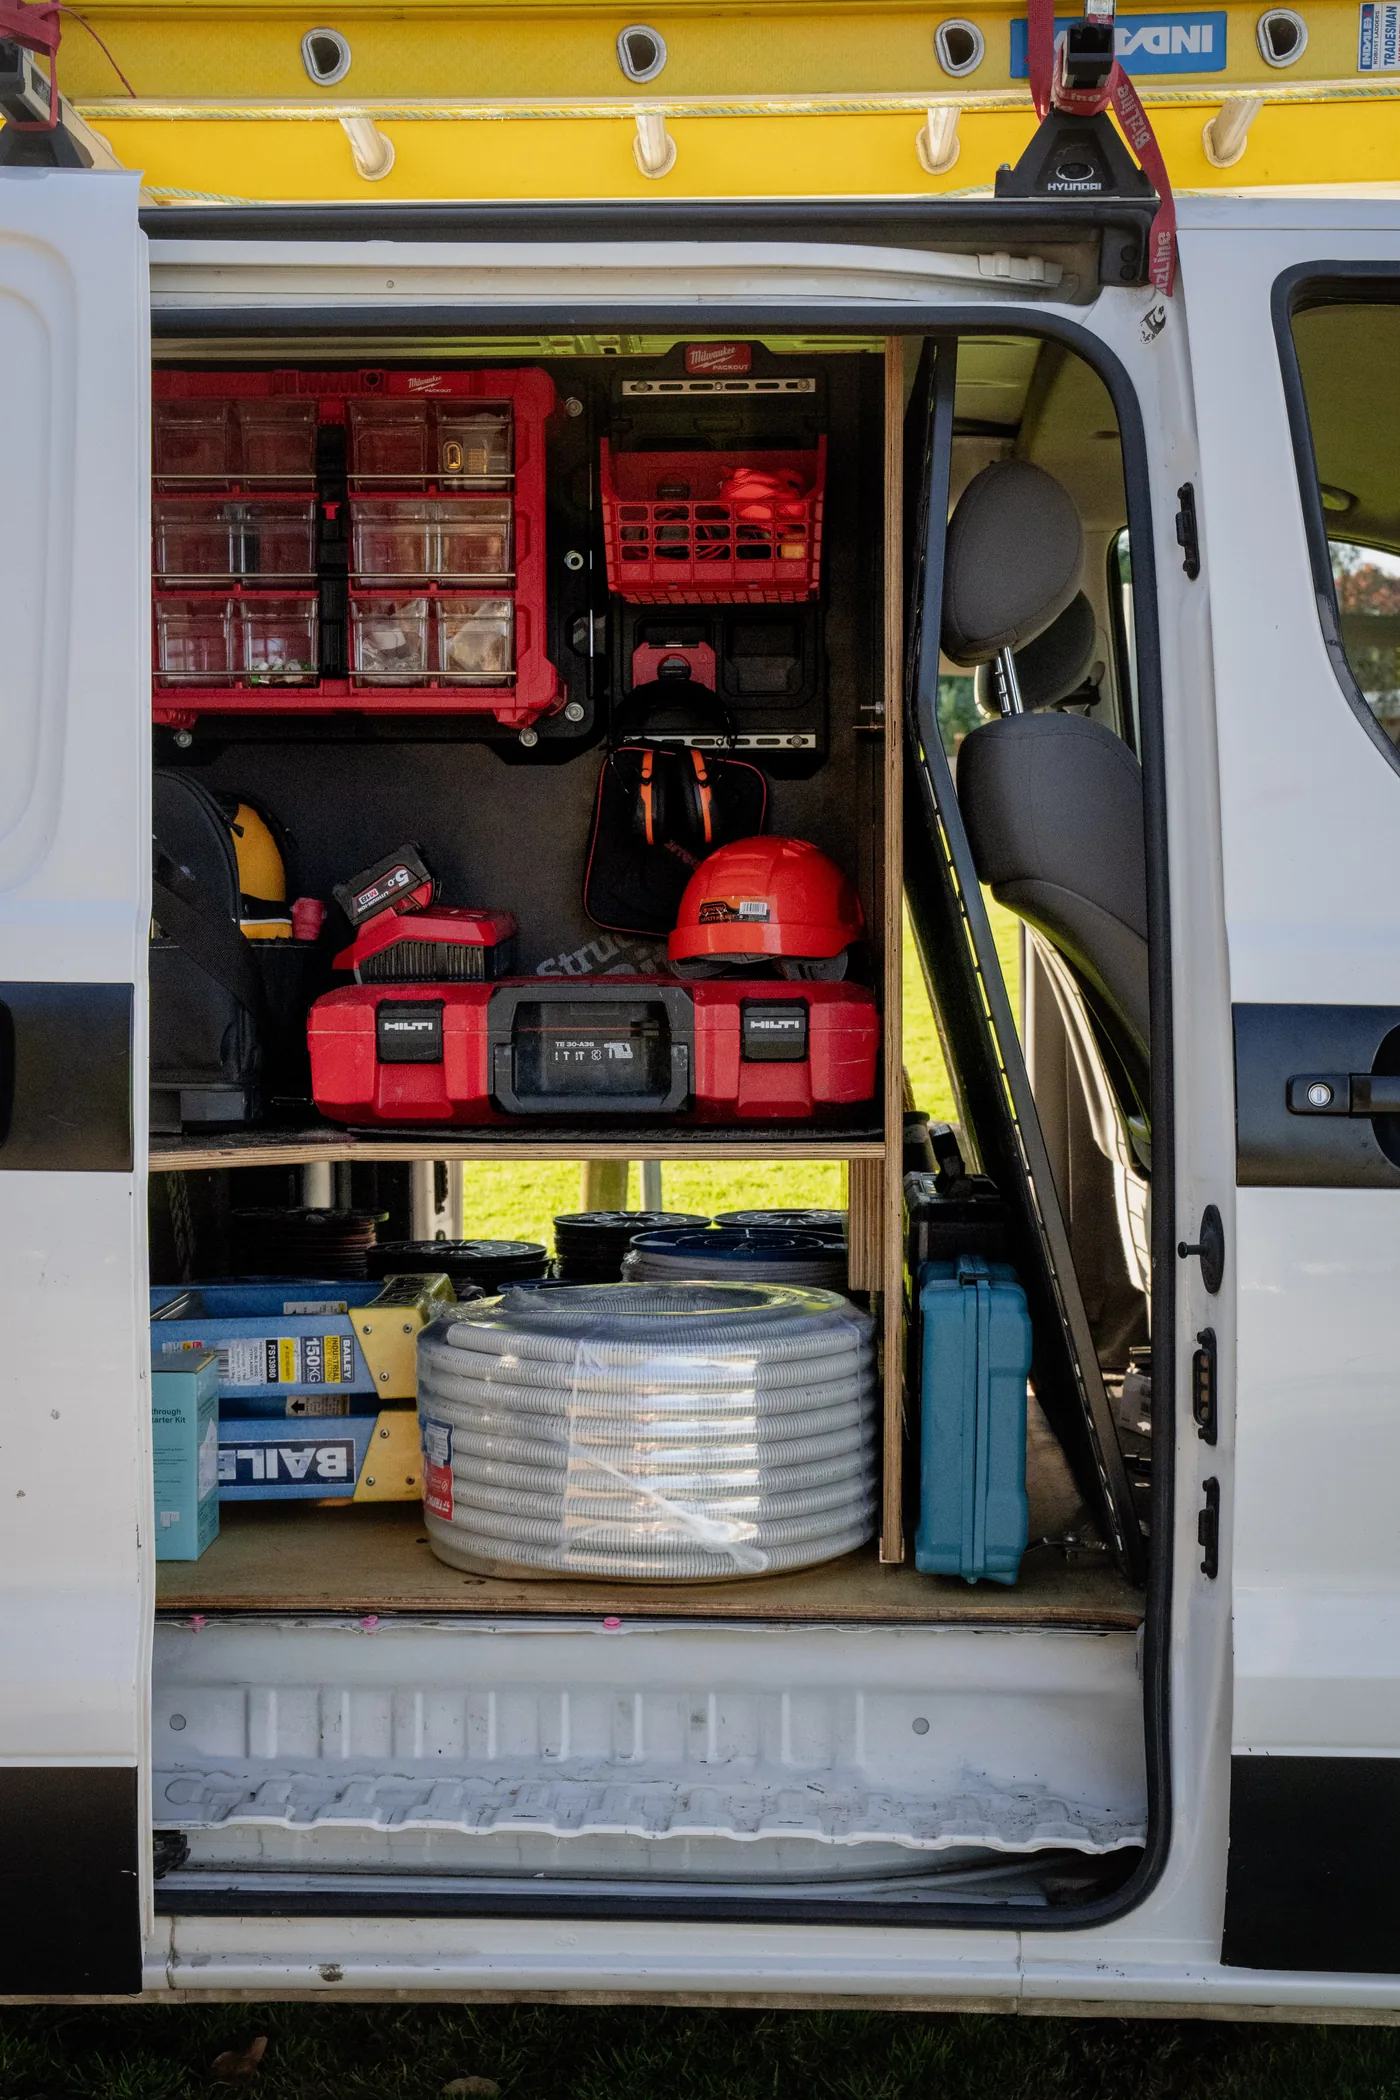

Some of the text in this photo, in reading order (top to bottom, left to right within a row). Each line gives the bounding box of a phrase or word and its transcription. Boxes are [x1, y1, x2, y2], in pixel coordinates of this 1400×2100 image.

[1384, 6, 1397, 66] TRADESMAN
[1048, 182, 1102, 191] HYUNDAI
[690, 346, 736, 365] Milwaukee
[407, 375, 442, 389] Milwaukee
[360, 888, 379, 904] M18
[384, 1022, 433, 1030] HILTI
[750, 1020, 800, 1029] HILTI
[268, 1344, 277, 1379] FS13980
[332, 1337, 340, 1382] INDUSTRIAL
[342, 1339, 352, 1379] BAILEY
[325, 1357, 333, 1382] RATING
[175, 1416, 186, 1424] Kit
